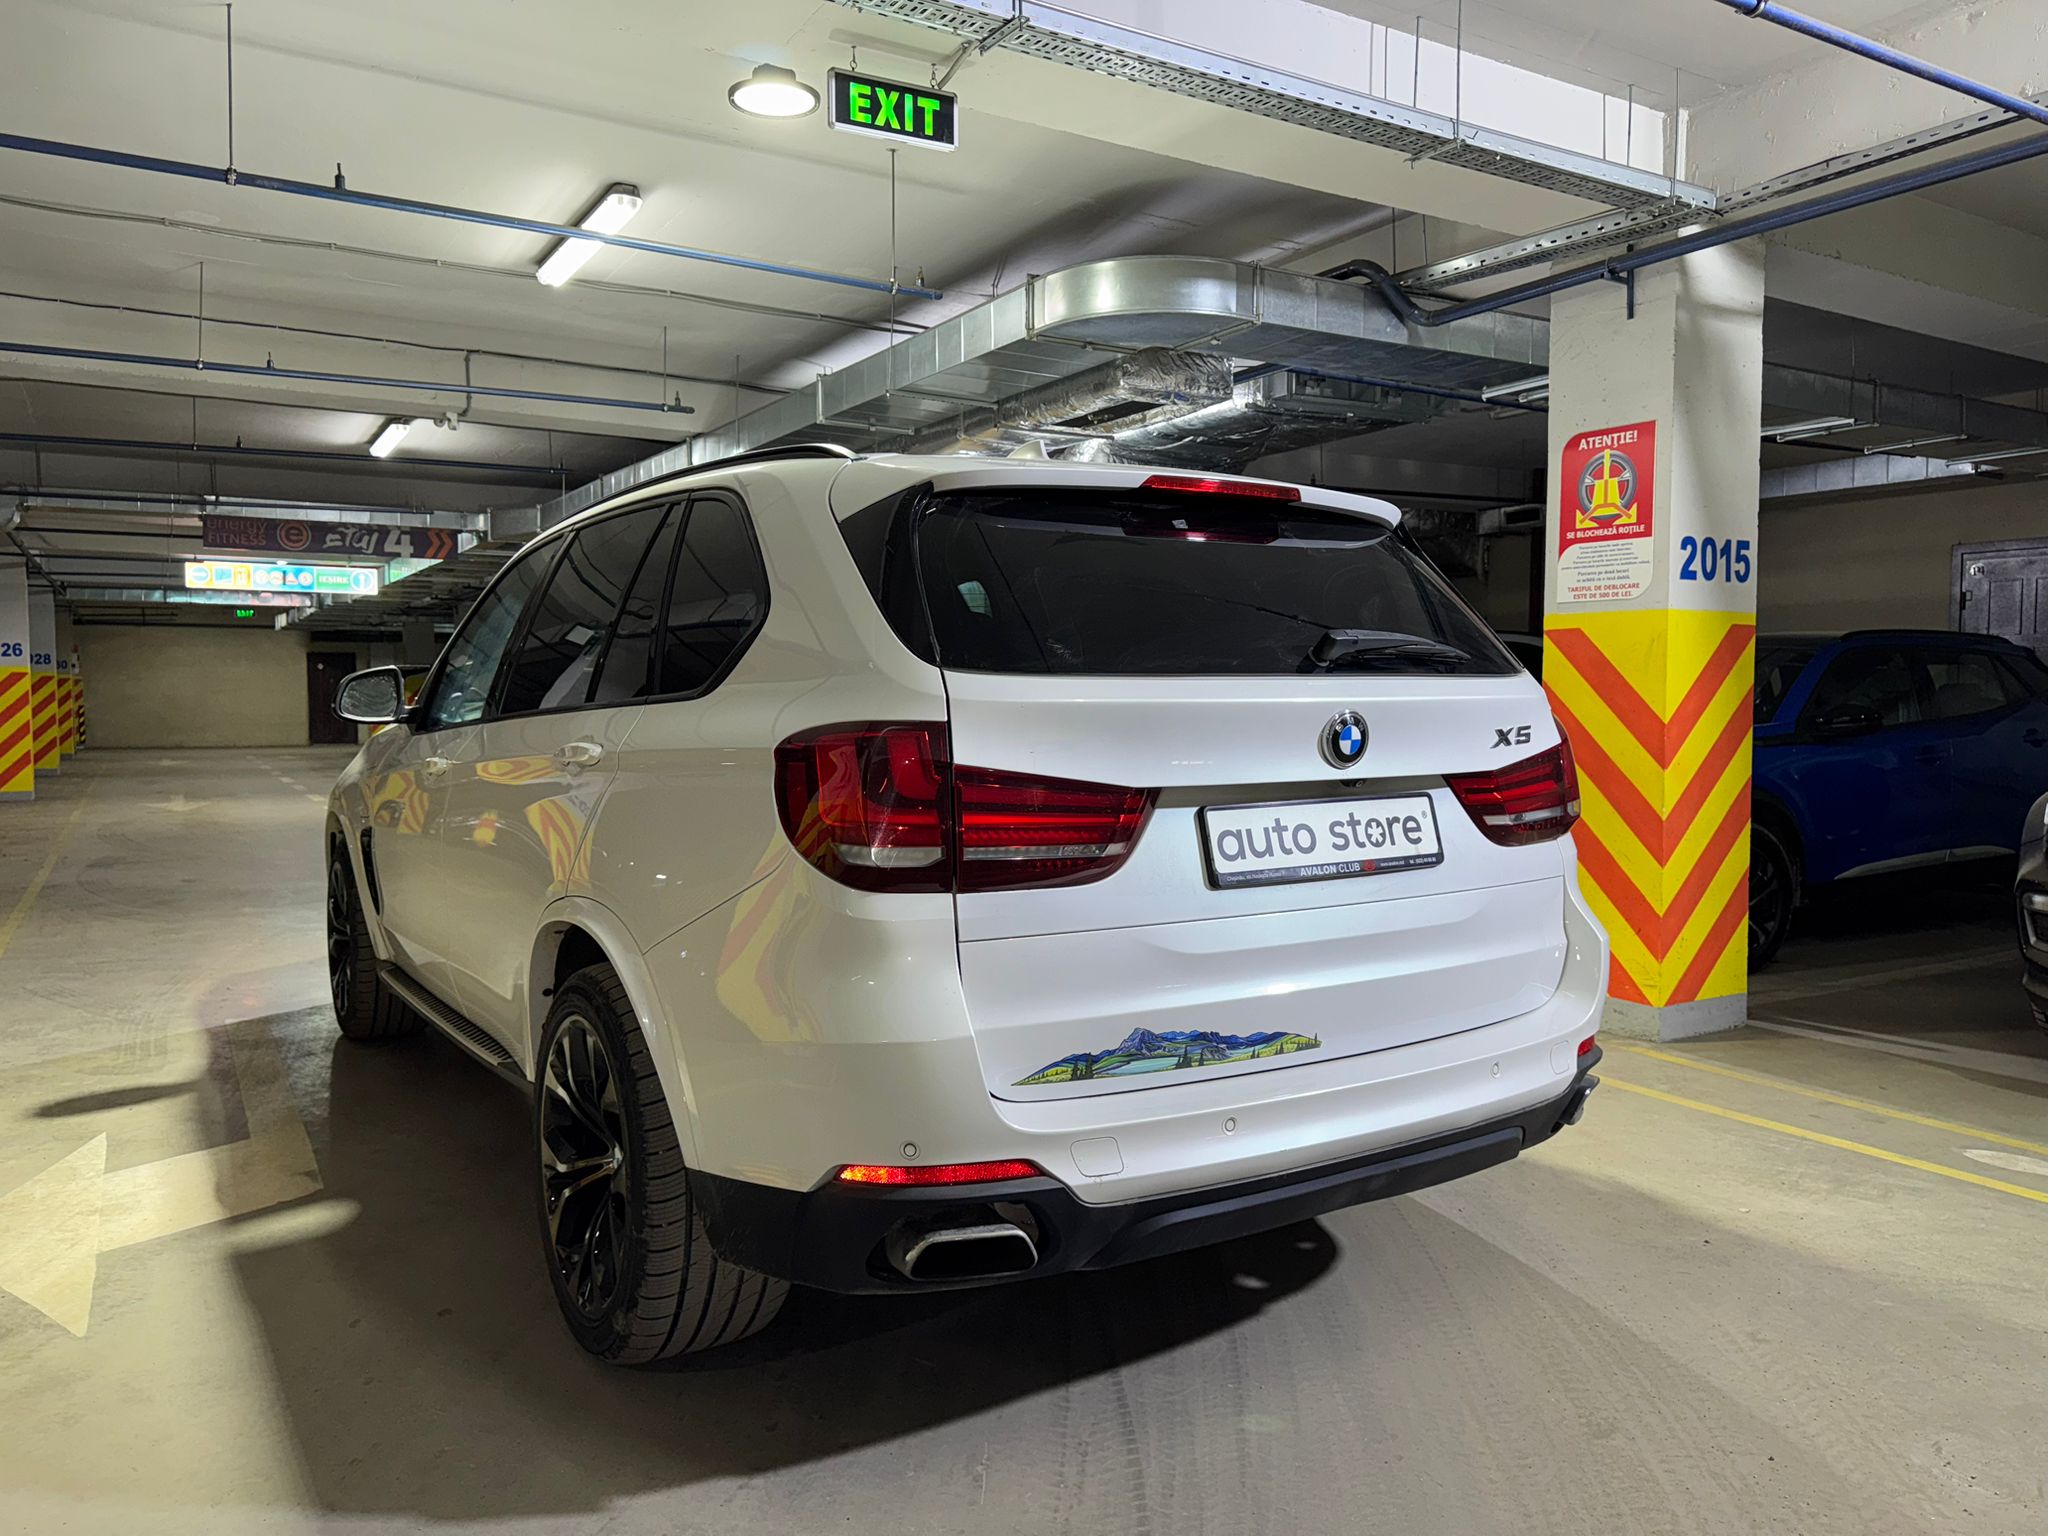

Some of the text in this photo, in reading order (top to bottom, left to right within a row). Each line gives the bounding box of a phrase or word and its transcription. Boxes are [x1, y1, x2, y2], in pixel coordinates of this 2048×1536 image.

[849, 81, 941, 137] EXIT
[207, 532, 267, 546] FITNESS
[383, 525, 415, 558] 4
[1566, 531, 1575, 540] SE
[1679, 535, 1751, 584] 2015
[1603, 583, 1640, 591] DEBLOCARE
[1489, 724, 1532, 749] X5
[1216, 817, 1317, 863] auto
[1300, 864, 1337, 877] AVALON
[1338, 862, 1361, 873] CLUB
